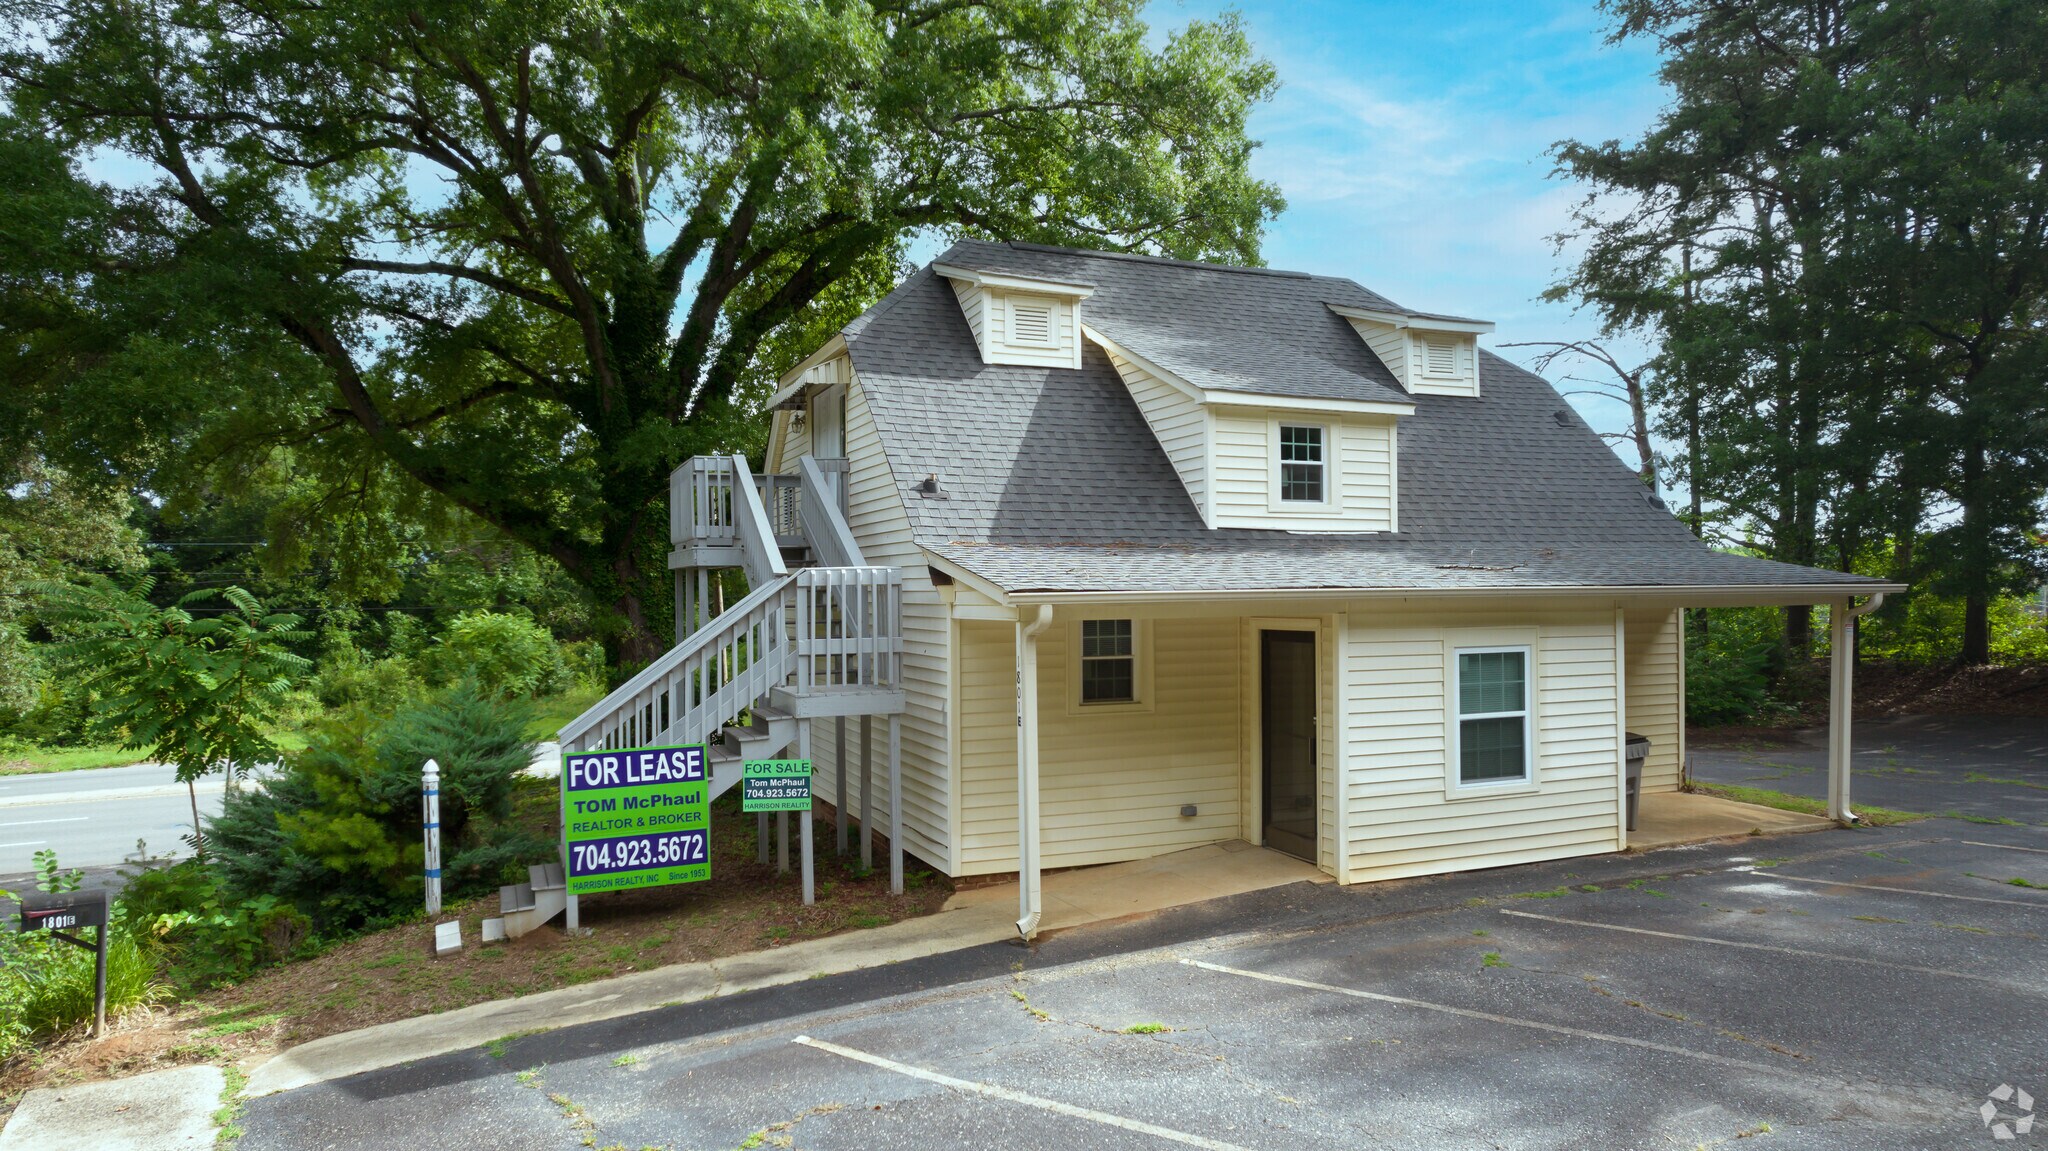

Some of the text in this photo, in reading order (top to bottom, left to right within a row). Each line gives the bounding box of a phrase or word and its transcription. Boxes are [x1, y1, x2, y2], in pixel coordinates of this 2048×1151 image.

[570, 750, 701, 787] FOR LEASE
[745, 762, 810, 774] FOR SALE
[750, 778, 805, 787] Tom McPhaul
[746, 788, 809, 798] 704.923.5672
[574, 791, 701, 814] TOM McPhaul
[744, 802, 780, 810] HARRISON
[572, 811, 702, 833] REALTOR & BROKER
[573, 834, 703, 872] 704.923.5672
[572, 873, 660, 891] HARRISON REALTY, INC
[668, 868, 706, 881] Since 1953
